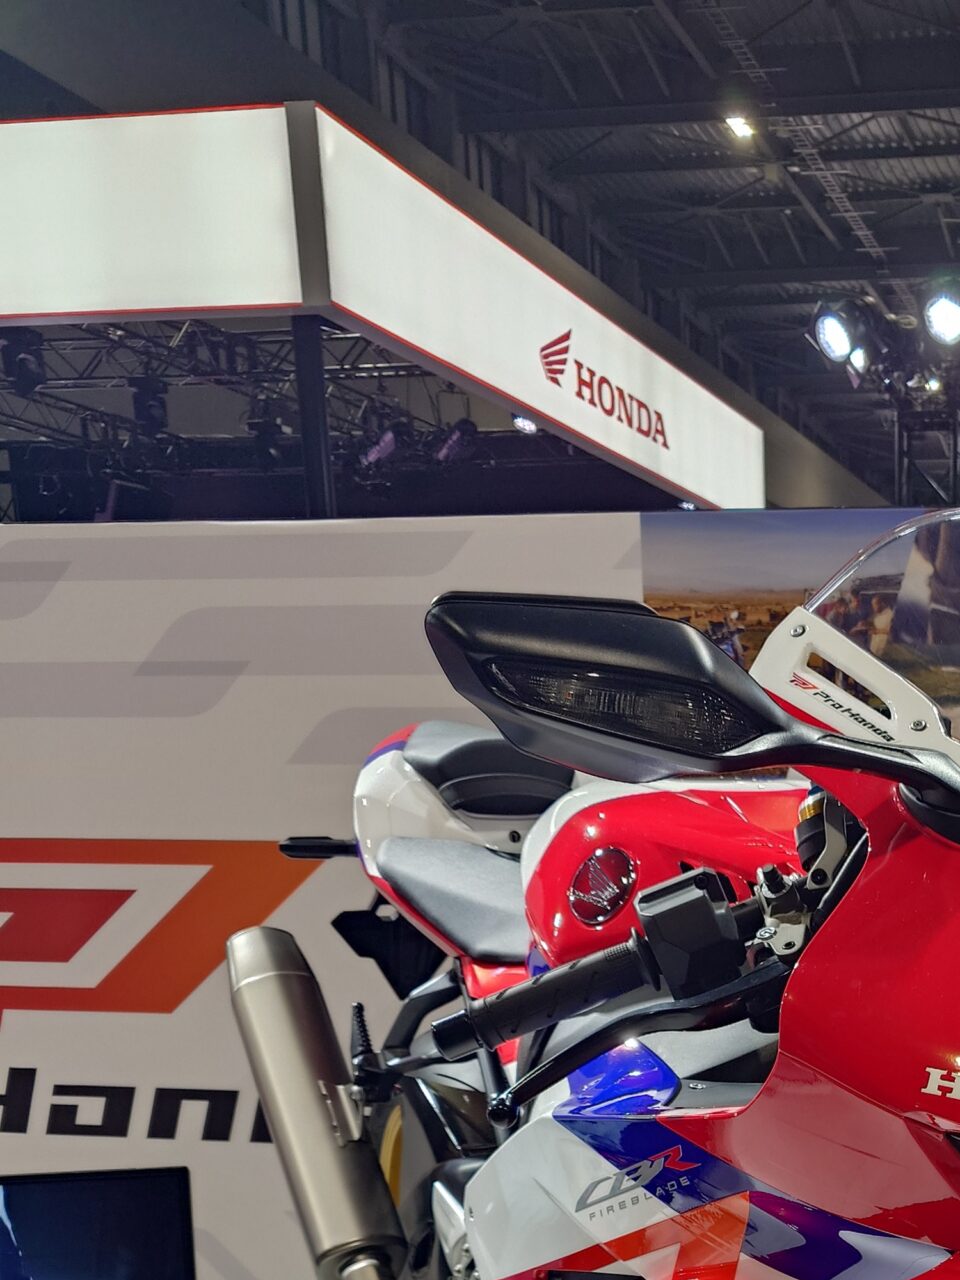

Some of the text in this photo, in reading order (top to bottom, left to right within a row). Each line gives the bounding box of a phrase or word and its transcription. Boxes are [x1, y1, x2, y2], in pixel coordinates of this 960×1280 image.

[574, 359, 669, 450] HONDA
[813, 691, 896, 742] Pro Honda
[575, 1145, 702, 1213] CBR
[588, 1175, 690, 1221] FIREBLADE
